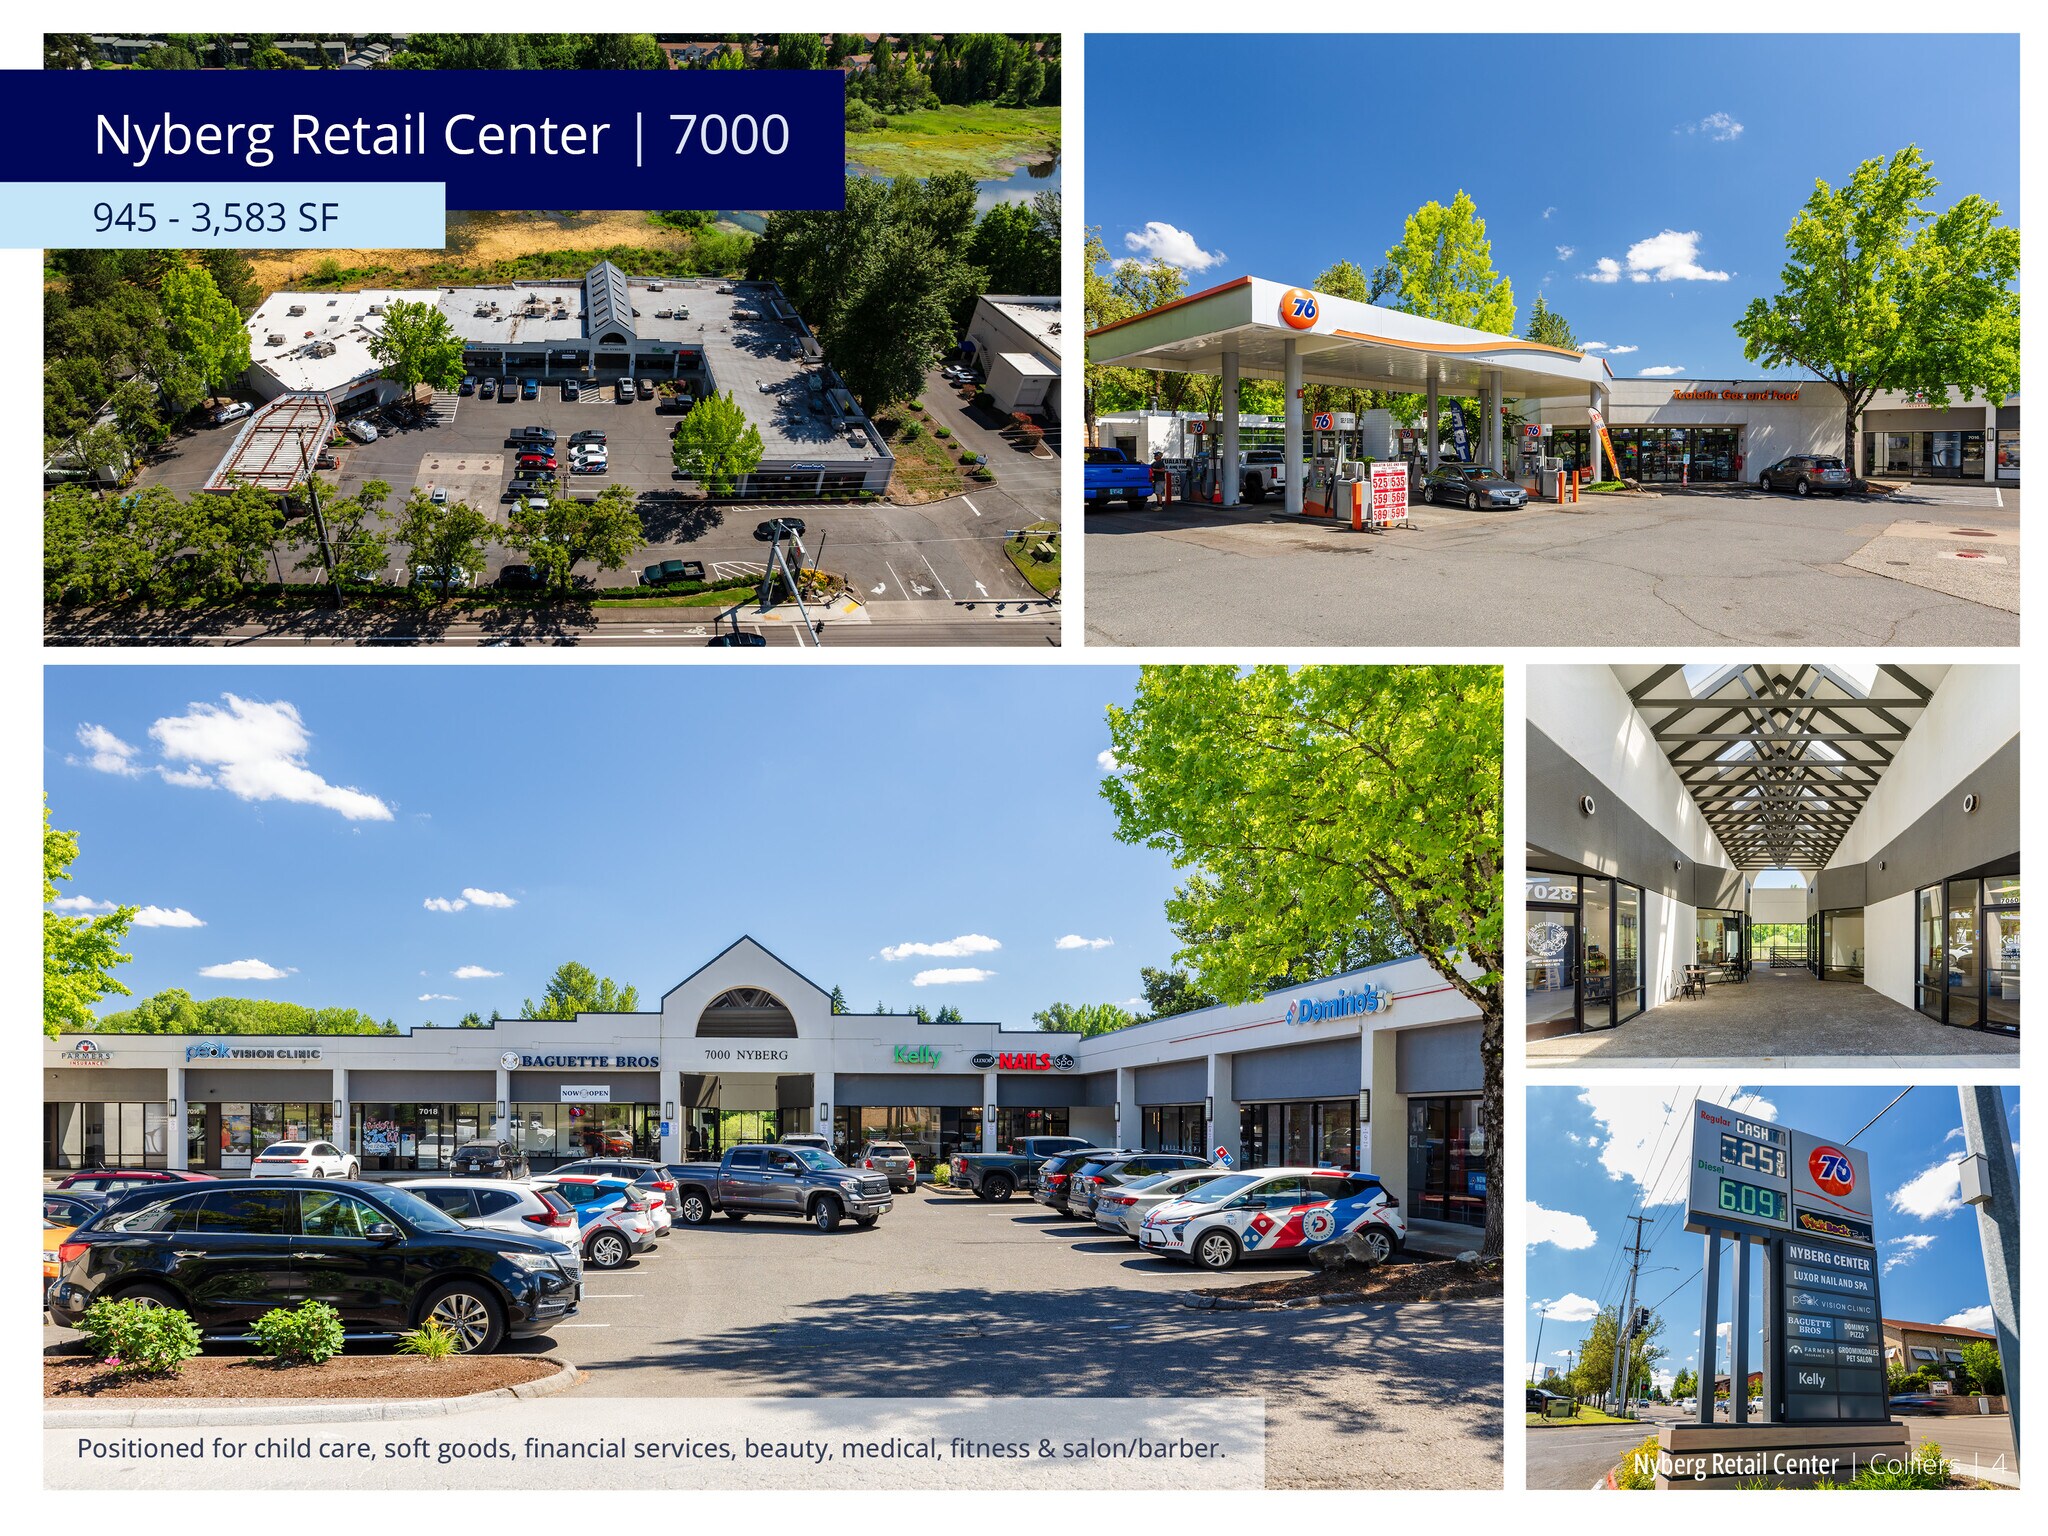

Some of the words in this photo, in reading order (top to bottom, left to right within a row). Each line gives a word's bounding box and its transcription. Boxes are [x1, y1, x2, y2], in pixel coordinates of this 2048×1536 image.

[1291, 298, 1316, 319] 76
[1673, 389, 1718, 400] Tualatin
[1721, 389, 1744, 400] Gas
[1747, 390, 1769, 400] and
[1771, 389, 1799, 400] Food
[1192, 422, 1203, 434] 76
[1314, 413, 1331, 429] 76
[1401, 429, 1411, 438] 76
[1527, 424, 1539, 436] 76
[1373, 477, 1388, 489] 525
[1391, 476, 1405, 488] 535
[1373, 493, 1388, 505] 559
[1391, 491, 1405, 503] 569
[1373, 509, 1388, 521] 589
[1391, 507, 1405, 519] 599
[1526, 884, 1574, 901] 7028
[1530, 921, 1565, 932] BAGUETTE
[1999, 934, 2020, 944] Kell
[1539, 949, 1557, 957] BROS
[1299, 982, 1378, 1025] Domino's
[186, 1042, 231, 1063] peak
[231, 1049, 275, 1059] VISION
[276, 1049, 321, 1059] CLINIC
[704, 1049, 731, 1060] 7000
[737, 1050, 788, 1061] NYBERG
[894, 1044, 943, 1070] Kelly
[521, 1055, 609, 1067] BAGUETTE
[615, 1055, 660, 1068] BROS
[998, 1053, 1051, 1070] NAILS
[1056, 1059, 1073, 1067] Spa
[1701, 1110, 1731, 1127] Regular
[1736, 1120, 1769, 1141] CASH
[1698, 1159, 1725, 1175] Diesel
[1818, 1155, 1852, 1185] 76
[1720, 1180, 1774, 1217] 6.09
[1790, 1246, 1831, 1264] NYBERG
[1833, 1255, 1870, 1271] CENTER
[1793, 1271, 1819, 1283] LUXOR
[1821, 1275, 1838, 1286] NAIL
[1838, 1279, 1853, 1288] AND
[1854, 1281, 1868, 1290] SPA
[1792, 1294, 1819, 1307] peak
[1821, 1302, 1846, 1310] VISION
[1847, 1304, 1871, 1314] CLINIC
[1788, 1316, 1832, 1328] BAGUETTE
[1844, 1323, 1870, 1332] DOMINO'S
[1799, 1326, 1822, 1334] BROS
[1850, 1331, 1865, 1339] PIZZA
[1804, 1346, 1835, 1355] FARMERS
[1838, 1346, 1880, 1357] GROOMINGDALES
[1846, 1355, 1857, 1363] PET
[1857, 1355, 1873, 1364] SALON
[1799, 1372, 1826, 1388] Kelly
